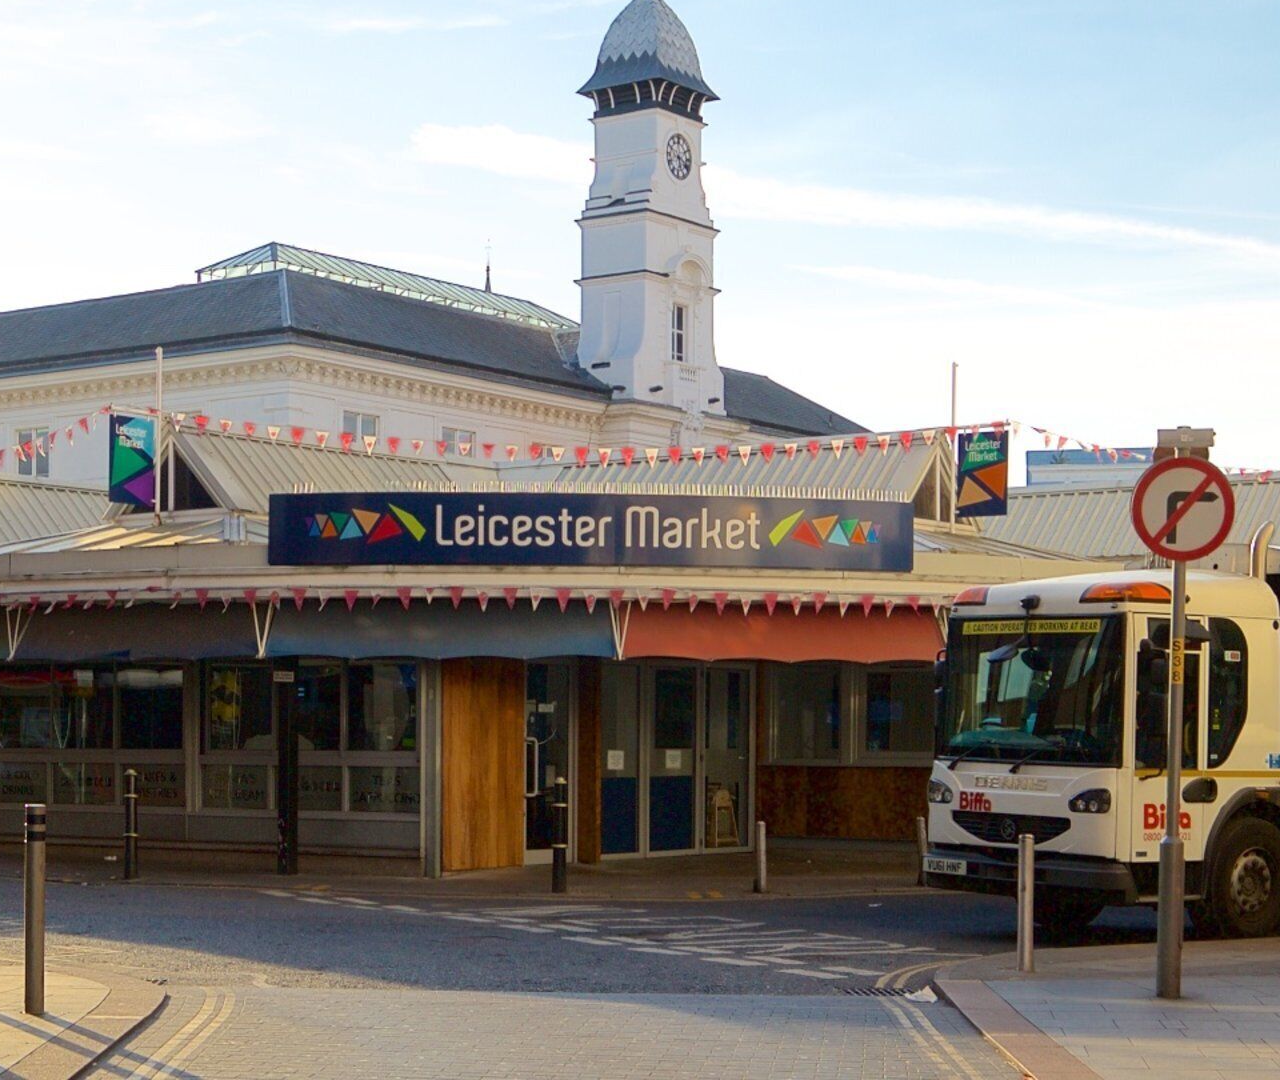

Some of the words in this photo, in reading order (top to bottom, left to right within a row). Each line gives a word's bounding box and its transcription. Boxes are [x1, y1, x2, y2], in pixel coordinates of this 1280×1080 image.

[116, 423, 147, 438] Leicester
[965, 440, 1001, 452] Leicester
[968, 451, 998, 463] Market
[435, 503, 613, 548] Leicester
[624, 505, 761, 550] Market
[973, 622, 998, 633] CAUTION
[1039, 621, 1069, 632] WORKING
[1070, 621, 1079, 631] AT
[1080, 621, 1099, 631] REAR
[959, 791, 992, 812] Biffa
[1143, 803, 1192, 830] Bia
[946, 861, 962, 873] HNF
